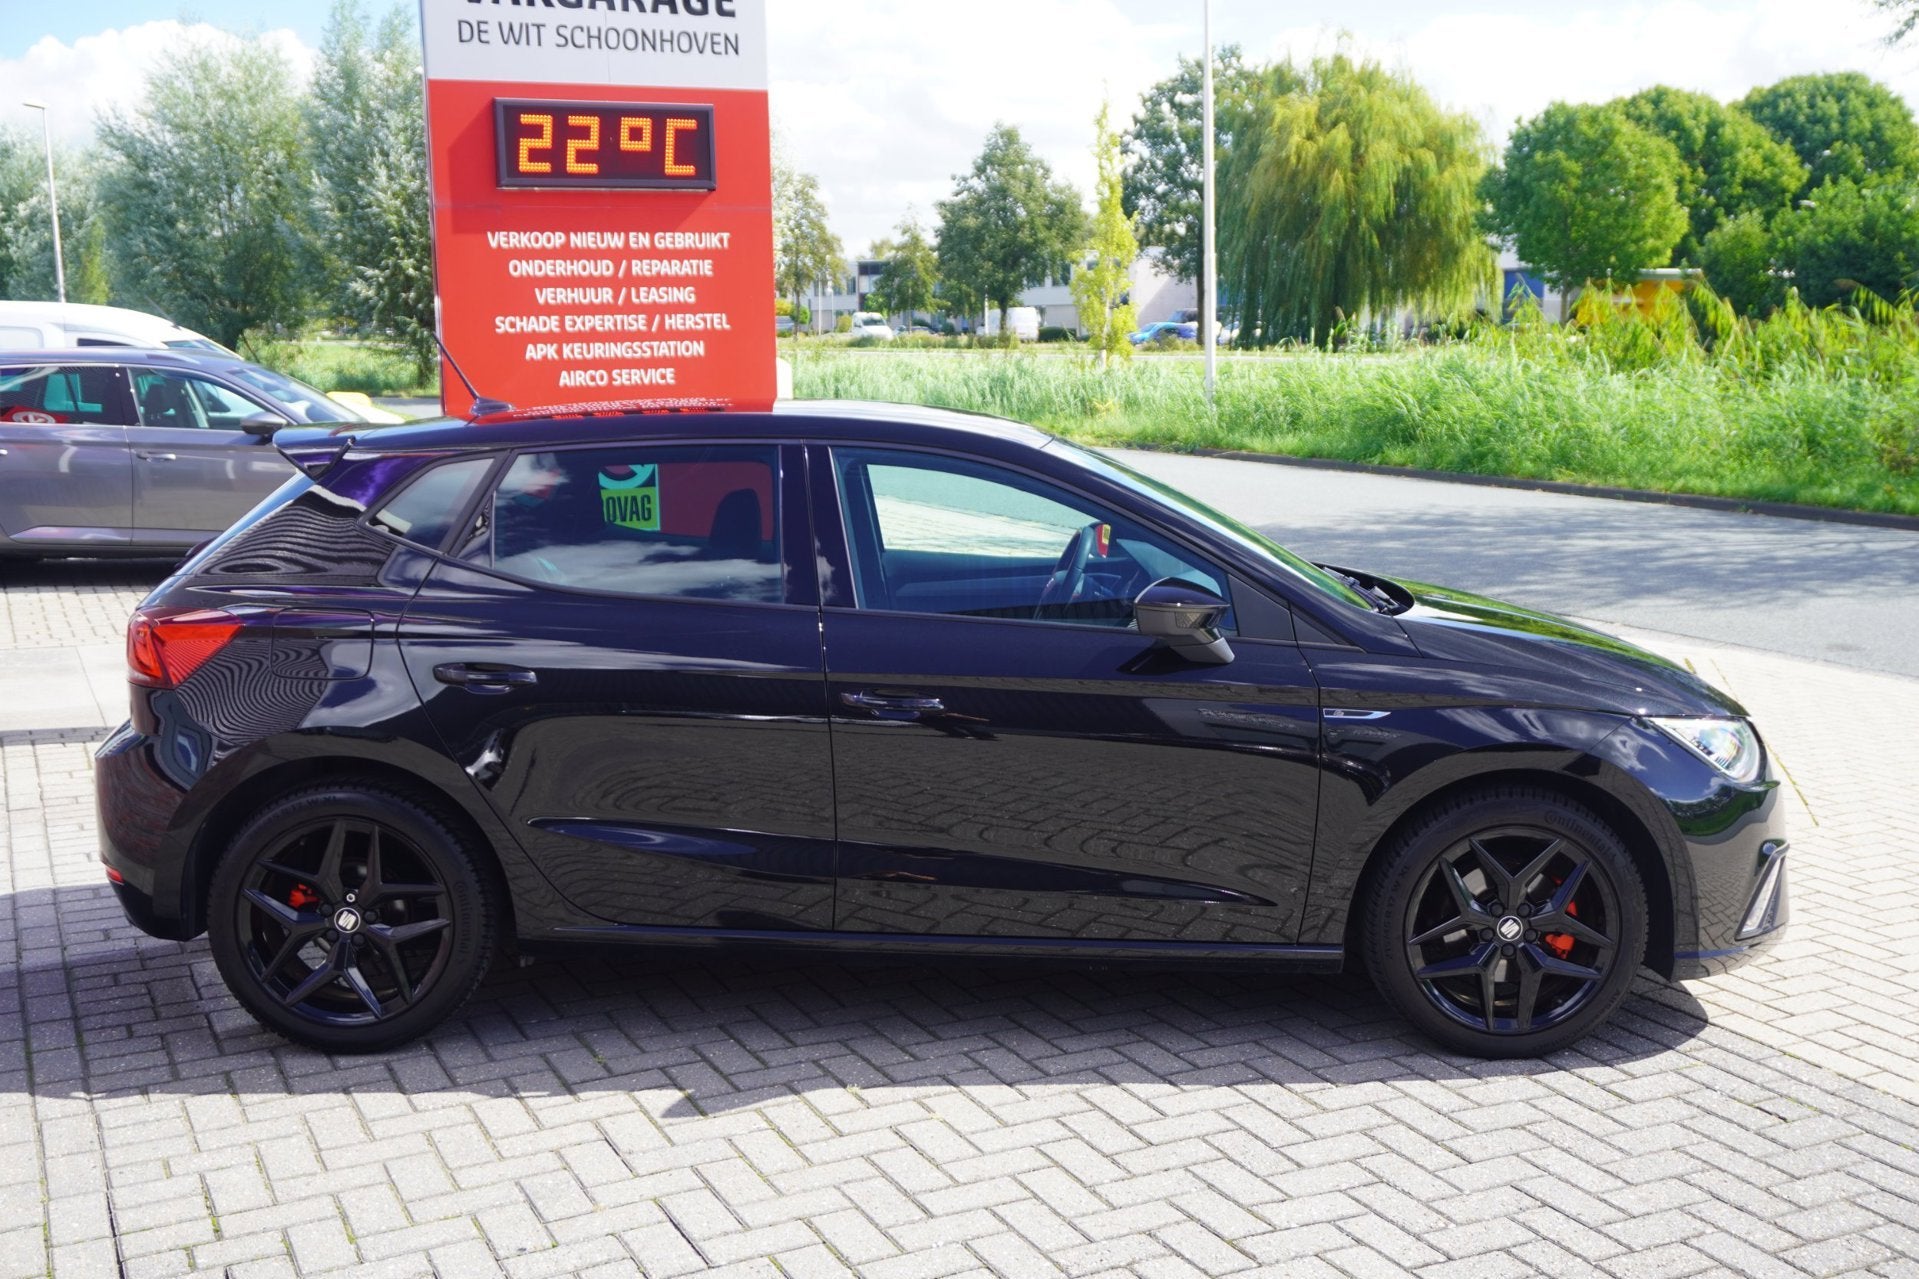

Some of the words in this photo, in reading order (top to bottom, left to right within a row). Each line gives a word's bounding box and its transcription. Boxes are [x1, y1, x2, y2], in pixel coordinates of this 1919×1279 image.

[457, 19, 490, 45] DE
[498, 21, 546, 47] WIT
[555, 24, 740, 56] SCHOONHOVEN
[487, 231, 565, 249] VERKOOP
[570, 231, 624, 249] NIEUW
[629, 232, 650, 249] EN
[654, 232, 730, 249] GEBRUIKT
[508, 259, 614, 277] ONDERHOUD
[618, 260, 627, 278] /
[631, 259, 713, 276] REPARATIE
[534, 287, 613, 304] VERHUUR
[618, 287, 627, 305] /
[630, 286, 696, 303] LEASING
[495, 315, 560, 333] SCHADE
[564, 314, 647, 332] EXPERTISE
[651, 314, 660, 333] /
[664, 313, 731, 330] HERSTEL
[525, 343, 559, 360] APK
[562, 340, 705, 360] KEURINGSSTATION
[558, 369, 608, 387] AIRCO
[612, 367, 676, 386] SERVICE
[605, 494, 652, 522] OVAG
